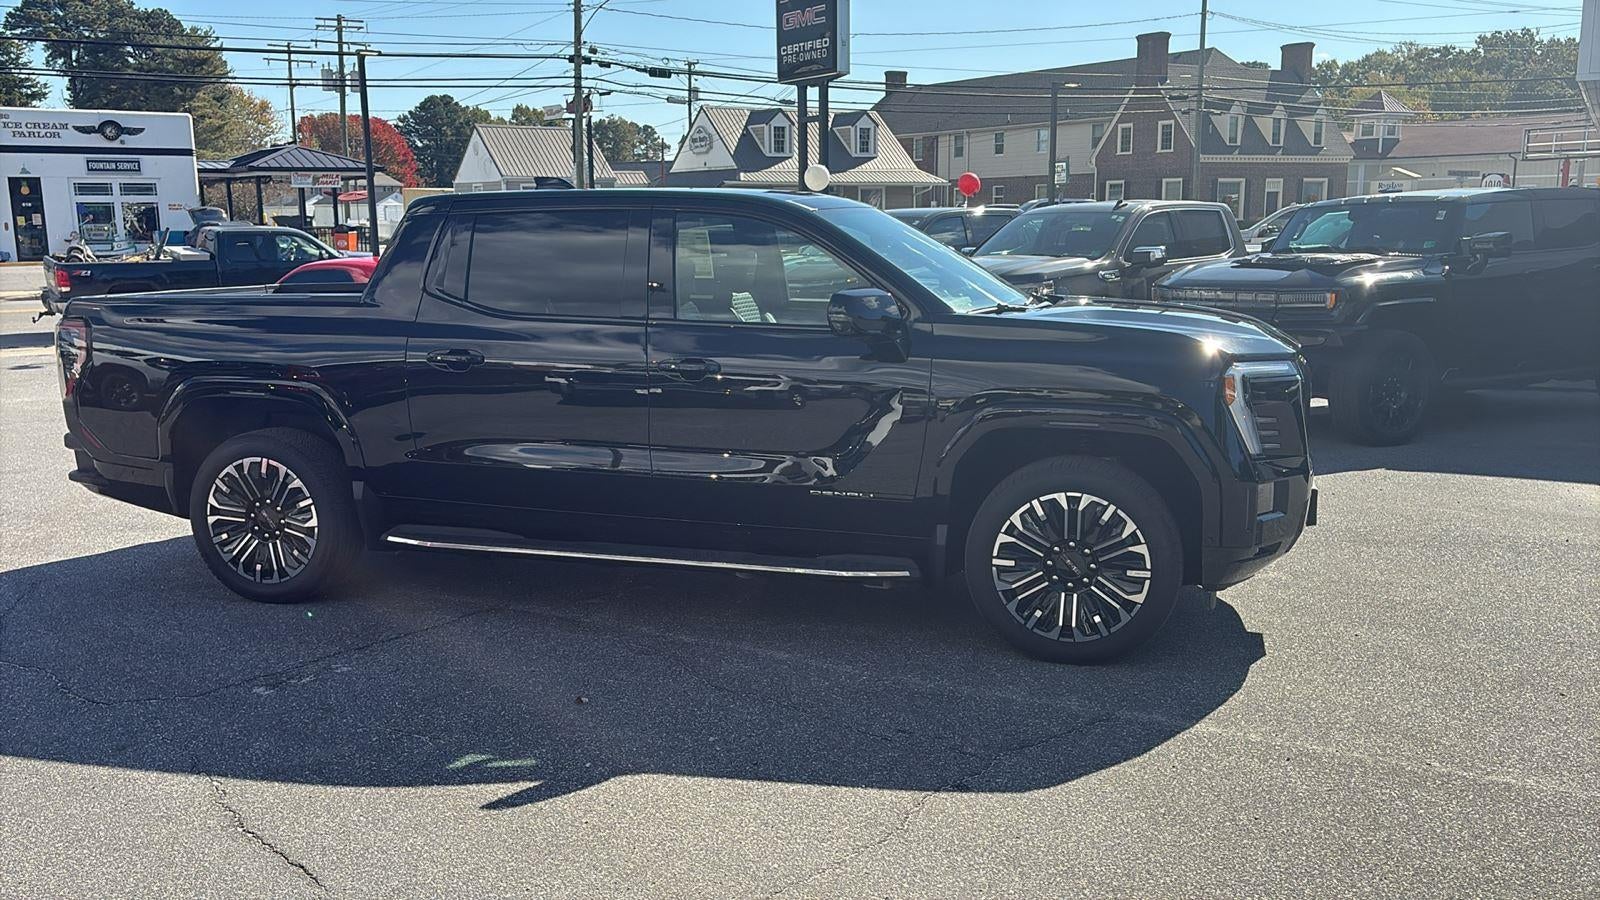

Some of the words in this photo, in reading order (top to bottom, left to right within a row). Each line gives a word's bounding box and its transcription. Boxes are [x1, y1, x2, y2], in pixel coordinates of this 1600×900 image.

[782, 4, 826, 30] GMC
[780, 38, 830, 55] CERTIFIED
[783, 48, 828, 64] PRE-OWNED
[2, 121, 22, 129] ICE
[25, 122, 69, 130] CREAM
[11, 130, 61, 139] PARLOR
[88, 162, 116, 170] FOUNTAIN
[118, 162, 139, 170] SERVICE
[809, 490, 873, 498] DENALI
